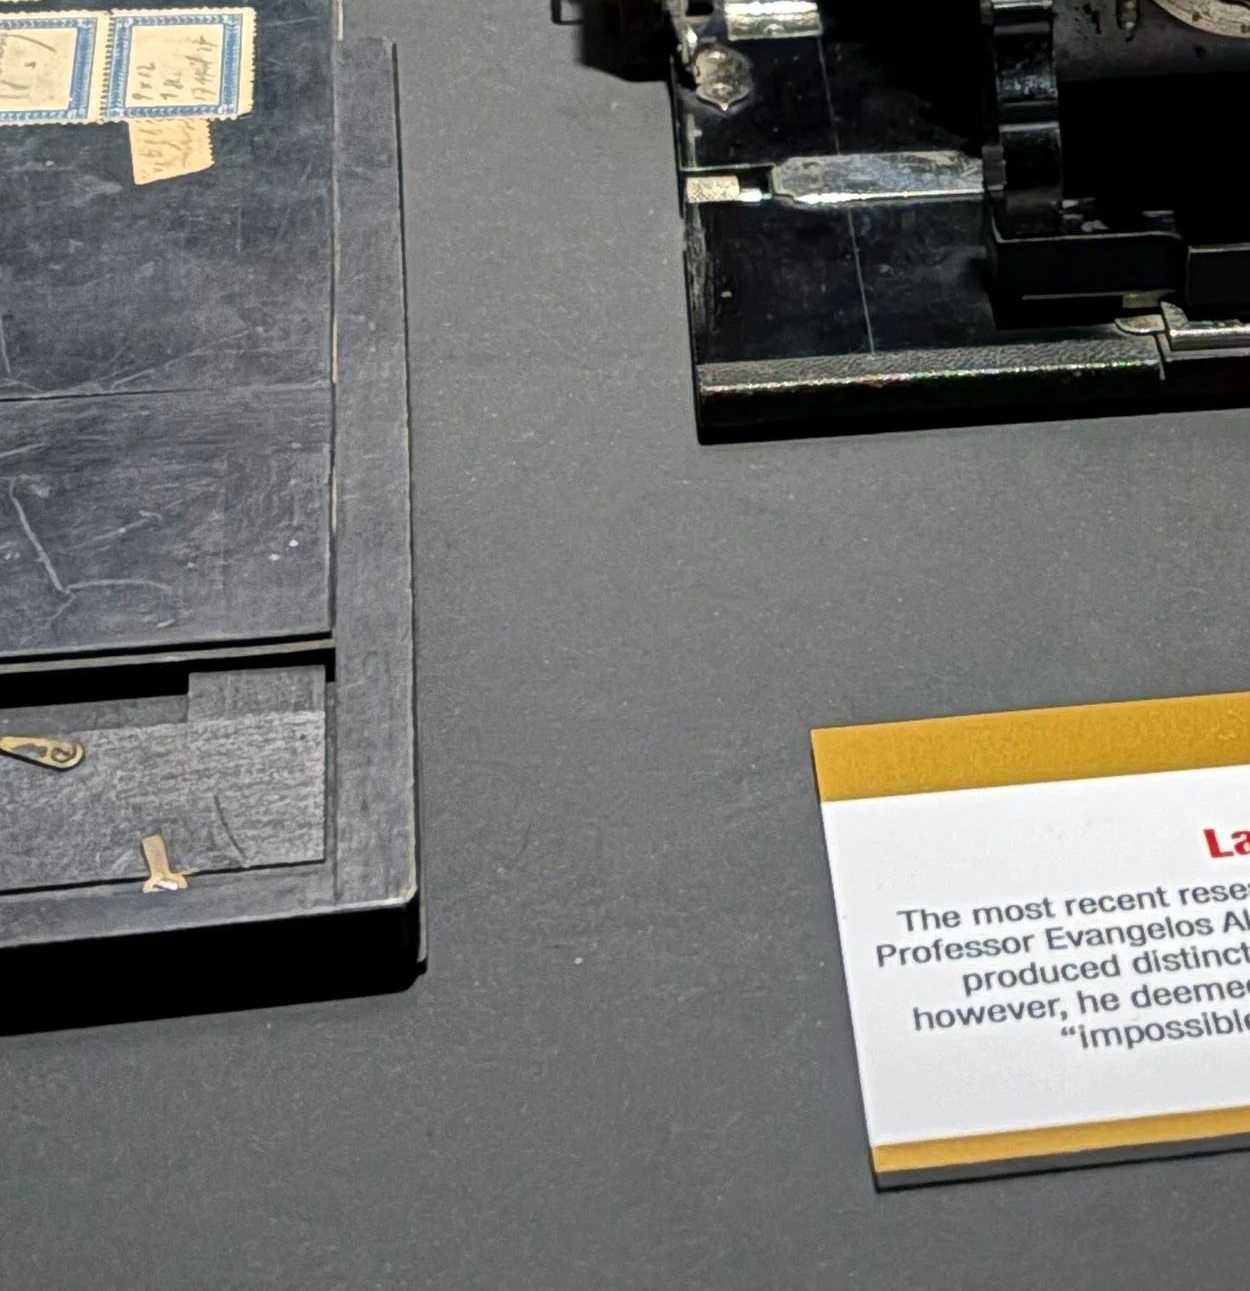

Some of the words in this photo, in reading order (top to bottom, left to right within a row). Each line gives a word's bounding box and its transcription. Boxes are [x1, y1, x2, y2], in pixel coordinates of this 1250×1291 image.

[896, 908, 961, 932] The
[972, 897, 1056, 926] most
[1064, 886, 1170, 917] recent
[876, 934, 1035, 968] Professor
[1044, 916, 1215, 951] Evangelos
[962, 953, 1121, 998] produced
[912, 997, 1068, 1031] however,
[1076, 990, 1121, 1015] he
